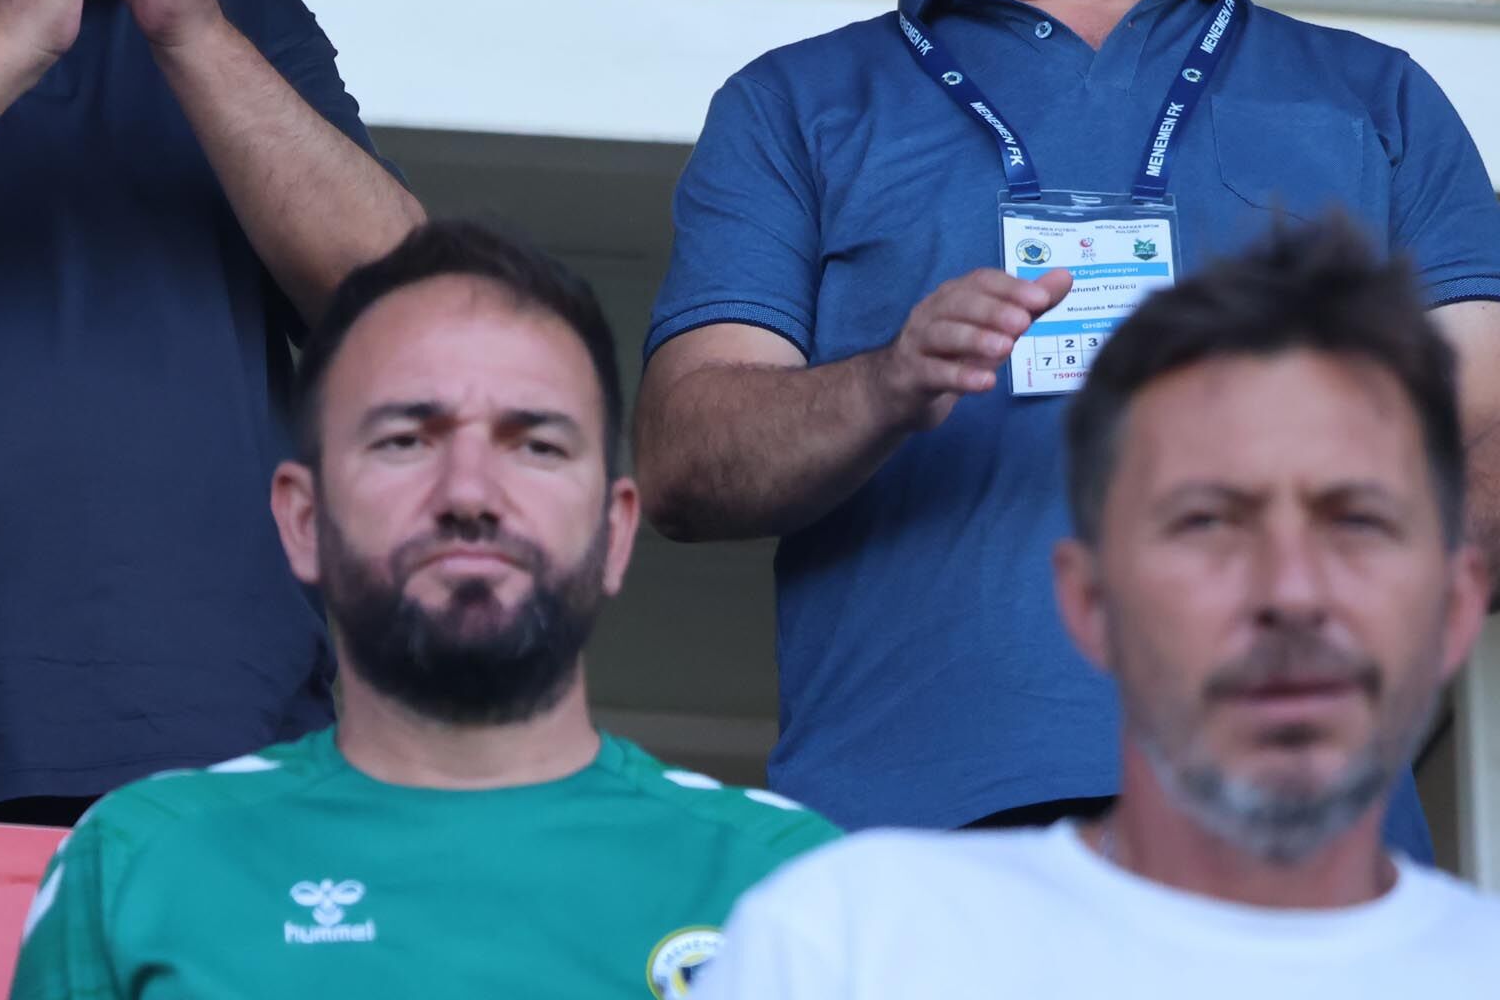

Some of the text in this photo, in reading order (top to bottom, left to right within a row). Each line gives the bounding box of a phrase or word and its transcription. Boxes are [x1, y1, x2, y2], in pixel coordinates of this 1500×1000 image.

[1200, 5, 1231, 54] MENEMEN
[917, 39, 933, 56] FK
[969, 101, 1025, 167] MENEMEN FK
[1146, 101, 1184, 177] MENEMEN FK
[1070, 285, 1100, 294] ehmet
[1064, 337, 1099, 349] 2 3
[1042, 355, 1076, 367] 7 8
[284, 919, 375, 944] hummel
